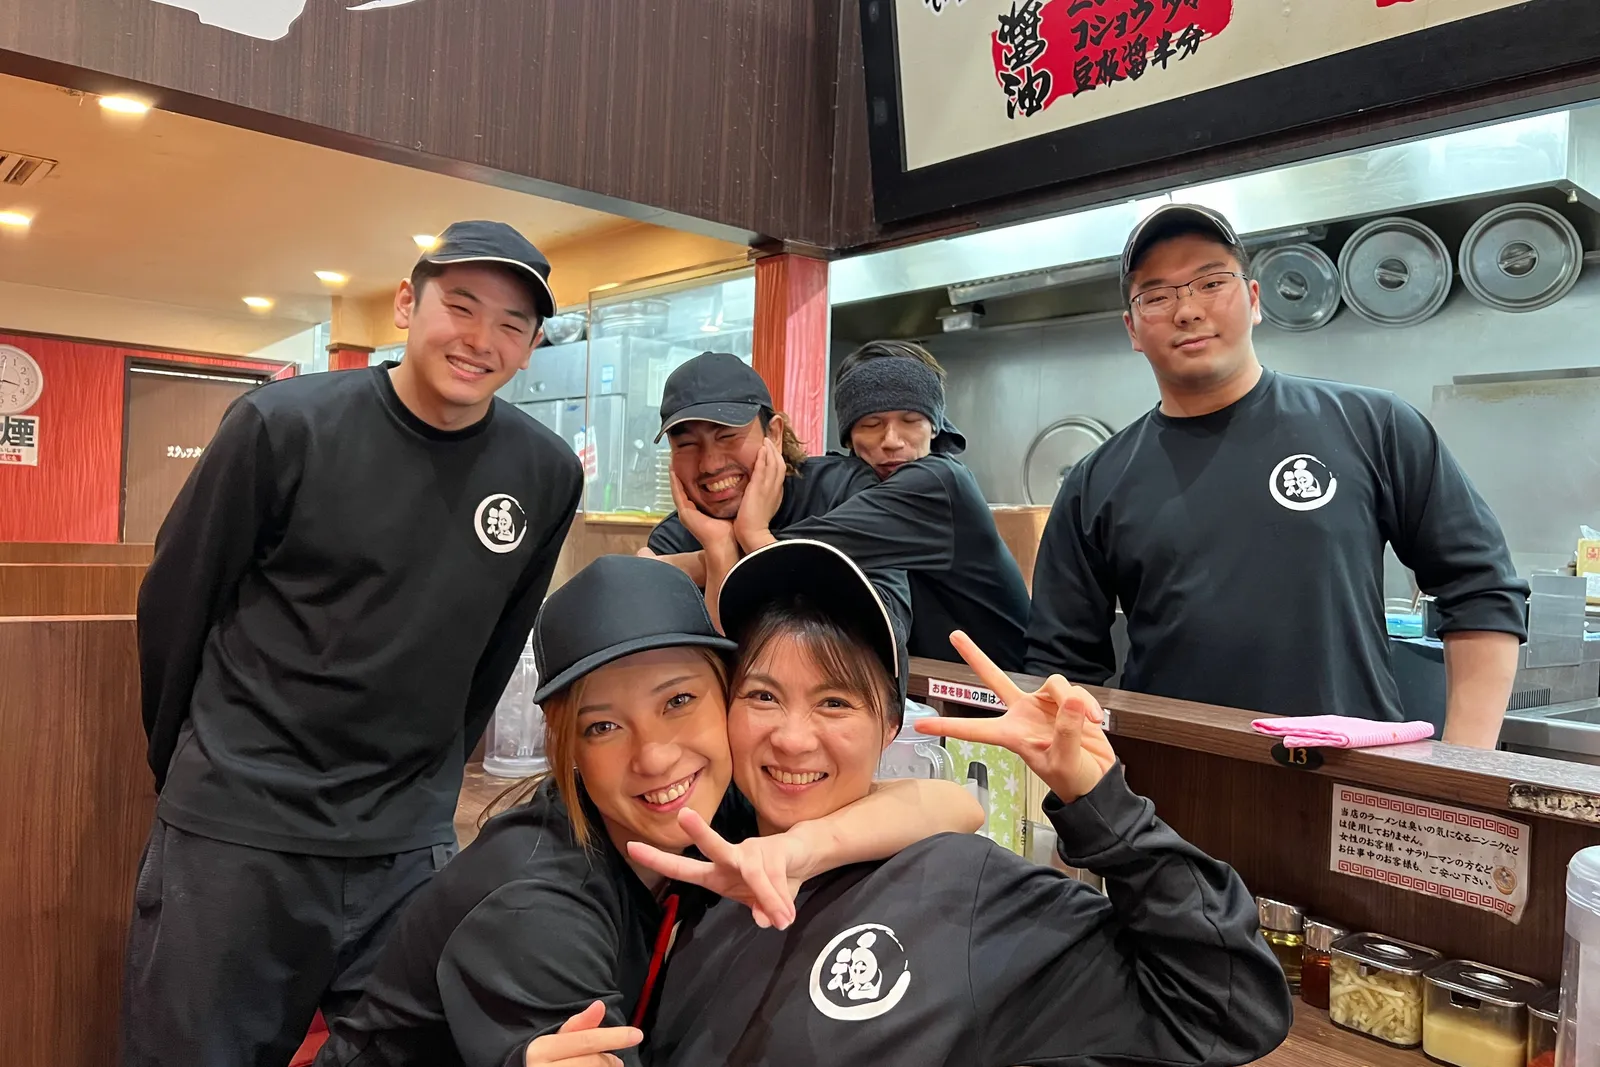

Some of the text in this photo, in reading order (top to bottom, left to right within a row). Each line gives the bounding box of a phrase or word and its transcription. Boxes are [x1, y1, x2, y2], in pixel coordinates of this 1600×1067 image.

[1071, 0, 1198, 50] コショウ
[167, 445, 205, 459] スタッフオ
[1287, 747, 1308, 765] 13
[1339, 819, 1423, 847] は使用しておりません。
